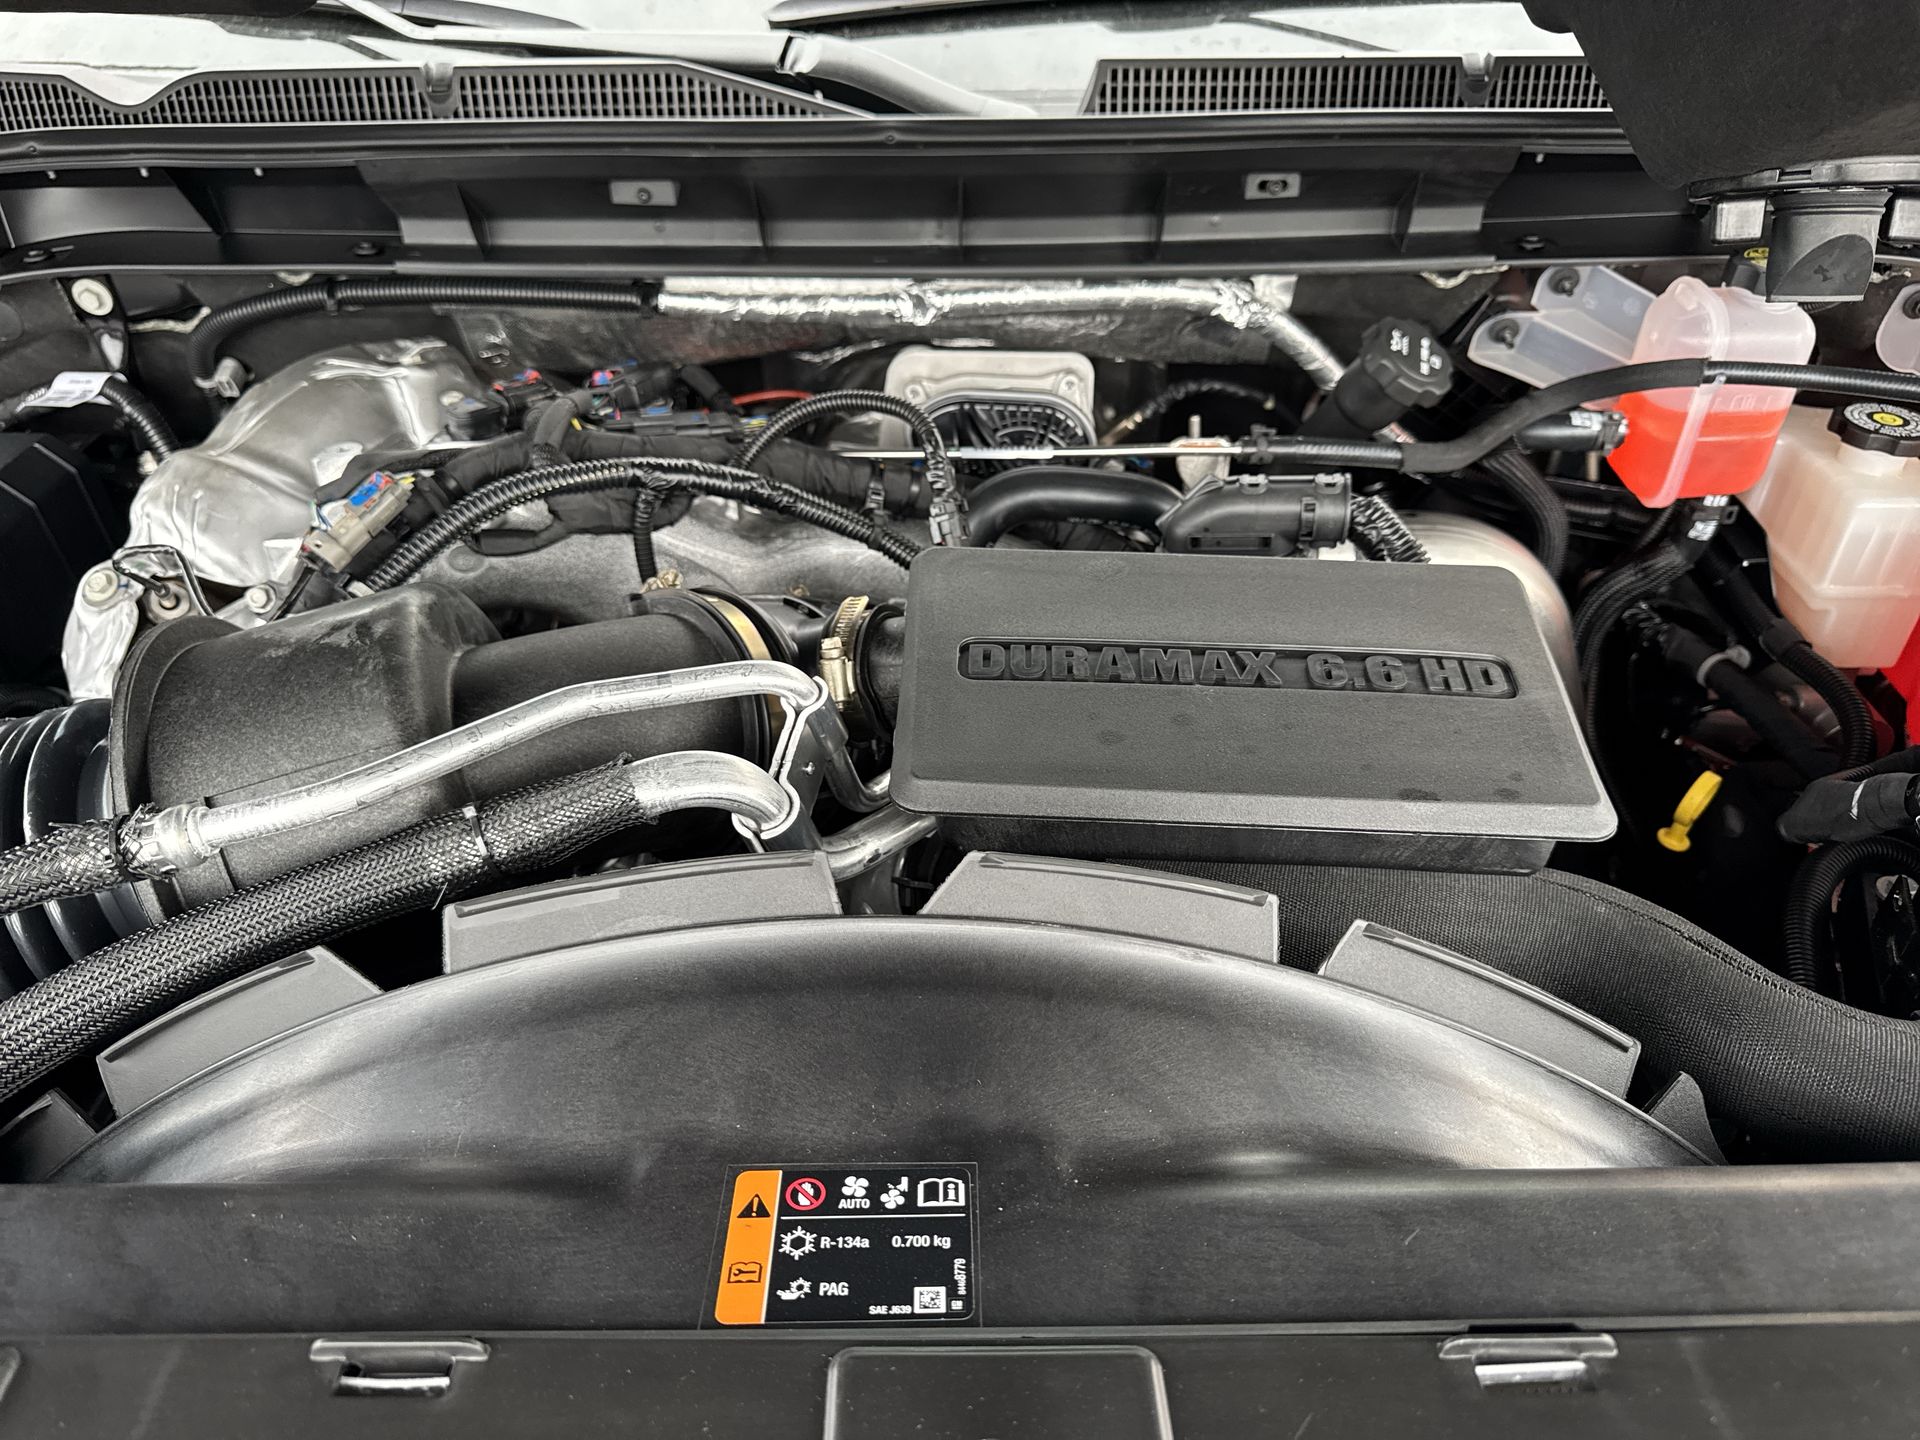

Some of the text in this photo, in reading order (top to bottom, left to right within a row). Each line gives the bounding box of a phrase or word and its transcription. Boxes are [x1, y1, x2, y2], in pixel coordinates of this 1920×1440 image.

[967, 643, 1510, 695] DURAMAX 6.6 HD
[838, 1198, 870, 1209] AUTO
[820, 1236, 870, 1249] R-134a
[891, 1234, 951, 1249] 0.700 kg
[819, 1282, 849, 1296] PAG
[868, 1305, 912, 1315] SAE J639
